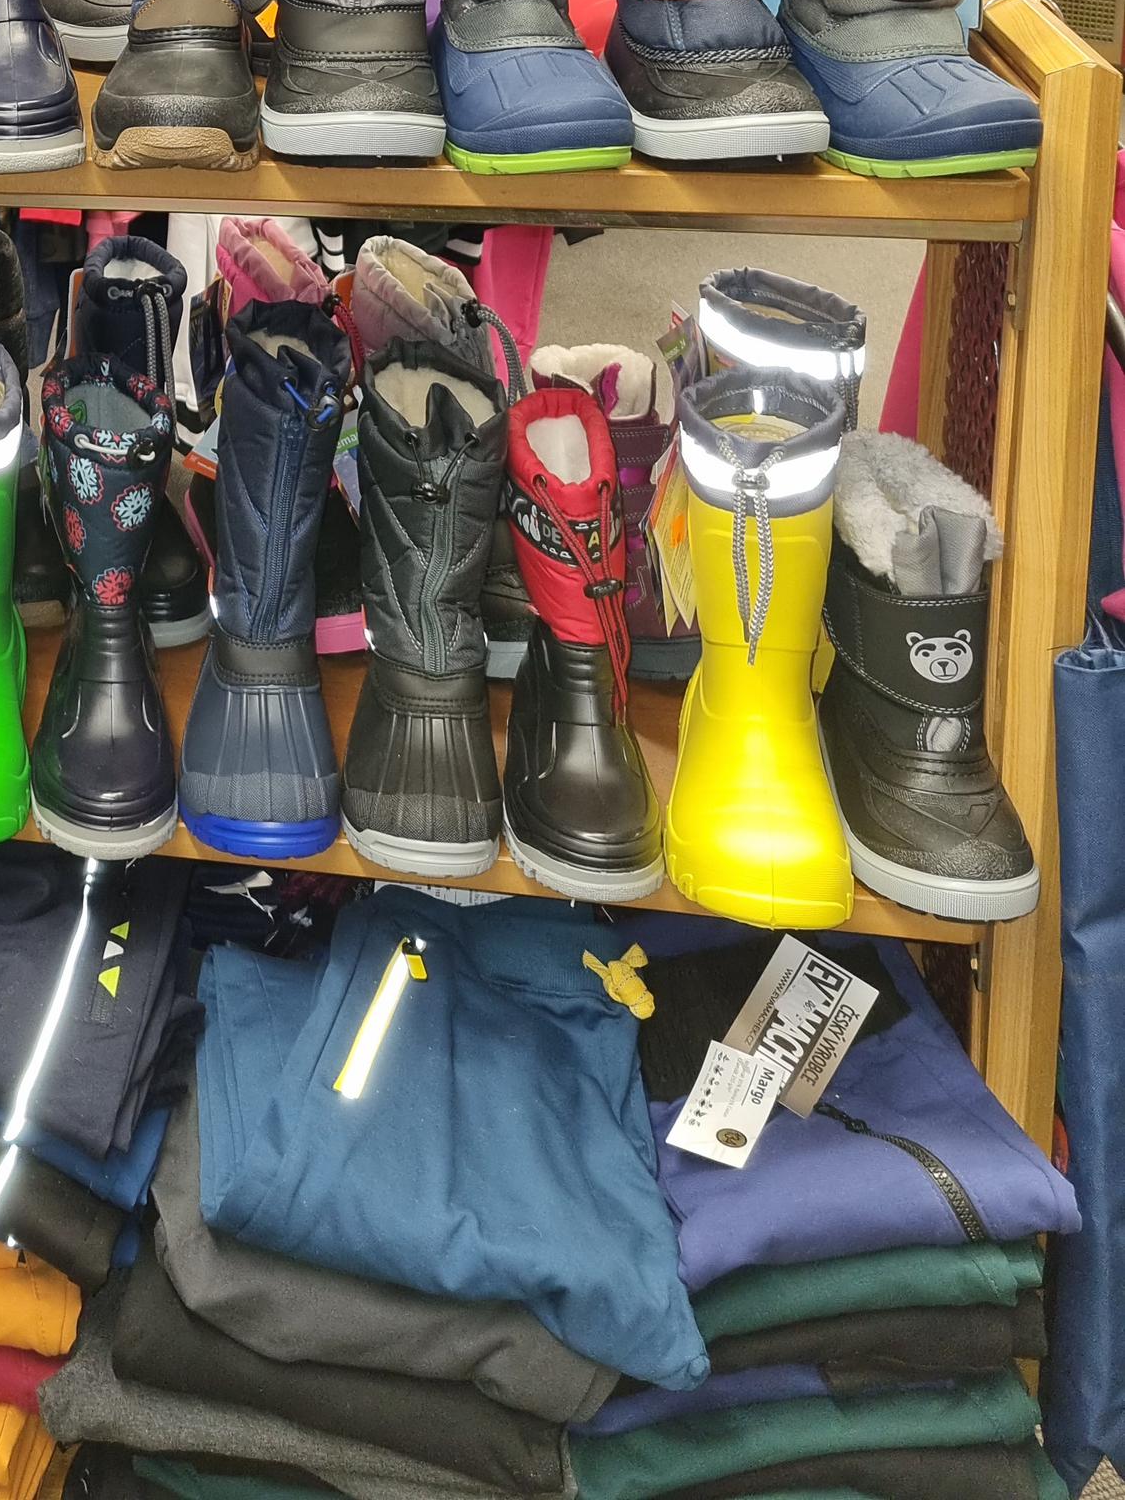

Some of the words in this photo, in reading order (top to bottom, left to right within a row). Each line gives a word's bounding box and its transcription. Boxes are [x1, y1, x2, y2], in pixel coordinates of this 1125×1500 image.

[827, 1004, 861, 1043] ČESKÝ
[800, 1036, 839, 1087] VÝROBCE
[750, 1067, 776, 1106] Margo
